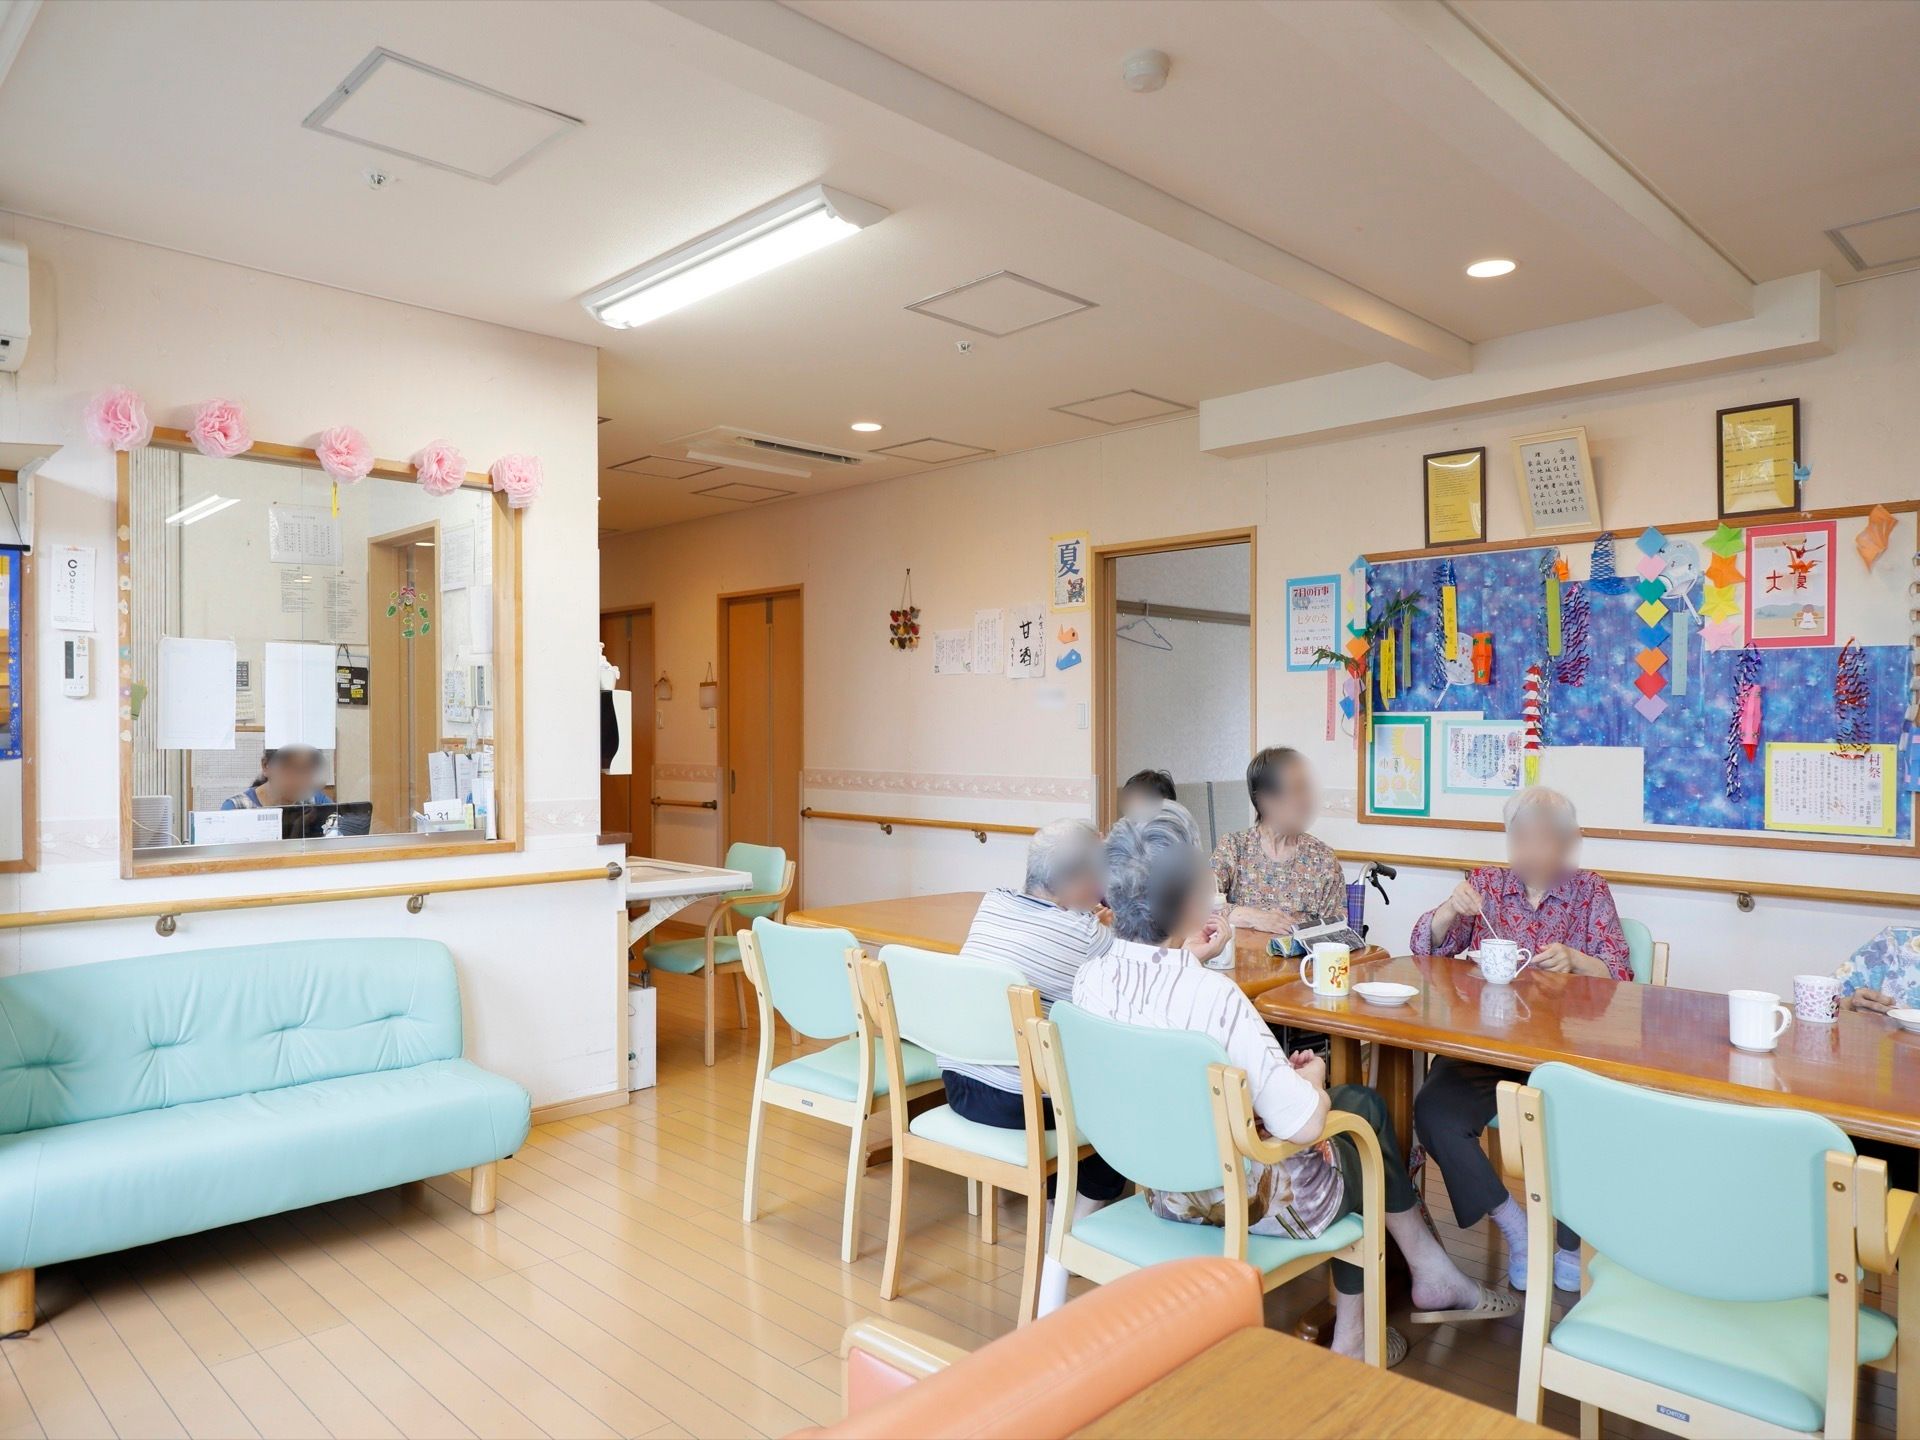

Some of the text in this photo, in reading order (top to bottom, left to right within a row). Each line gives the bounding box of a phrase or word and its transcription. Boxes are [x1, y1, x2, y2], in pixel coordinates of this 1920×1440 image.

[1058, 539, 1080, 578] 夏
[1293, 586, 1329, 597] 7月の行事
[1297, 613, 1328, 624] 七夕の会
[1019, 619, 1033, 667] 甘酒
[1869, 753, 1881, 779] 村祭
